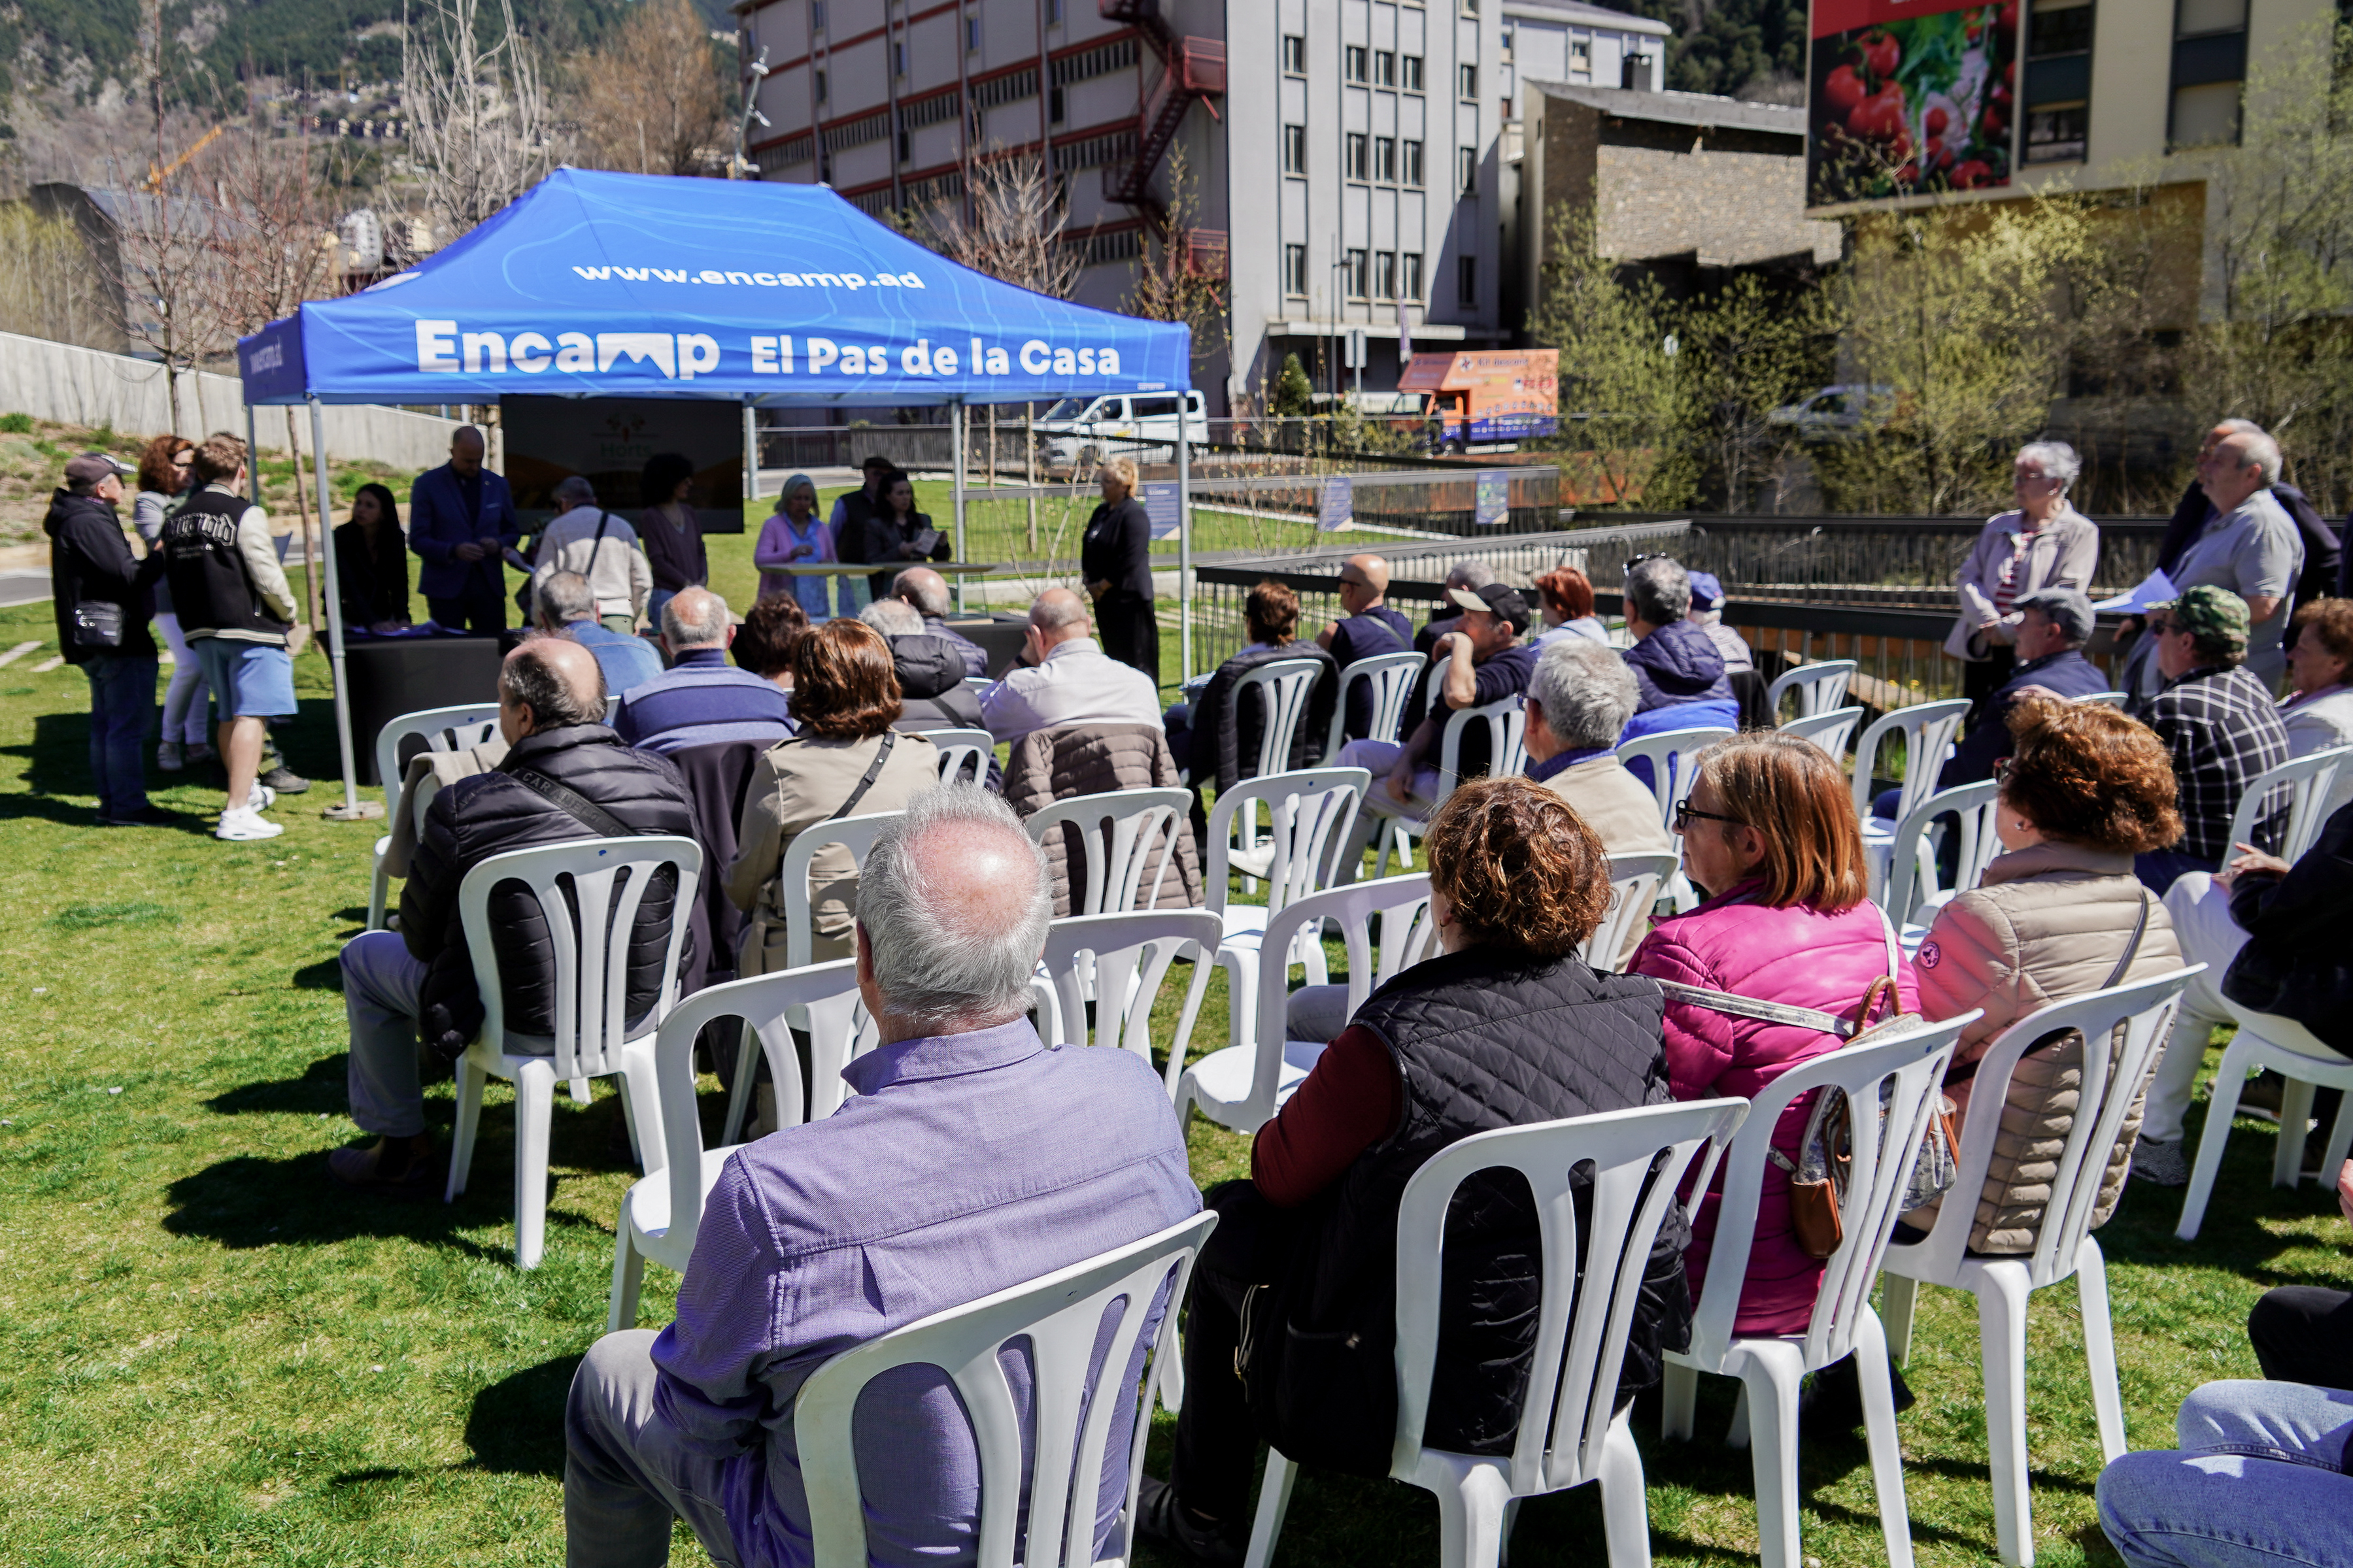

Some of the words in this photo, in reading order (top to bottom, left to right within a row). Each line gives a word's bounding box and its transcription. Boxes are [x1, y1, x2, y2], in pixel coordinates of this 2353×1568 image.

[571, 265, 926, 291] www.encamp.ad
[415, 318, 720, 380] Encamp
[750, 334, 794, 375] El
[806, 337, 889, 376] Pas
[900, 338, 960, 376] de
[970, 337, 1011, 376] la
[1018, 339, 1122, 376] Casa
